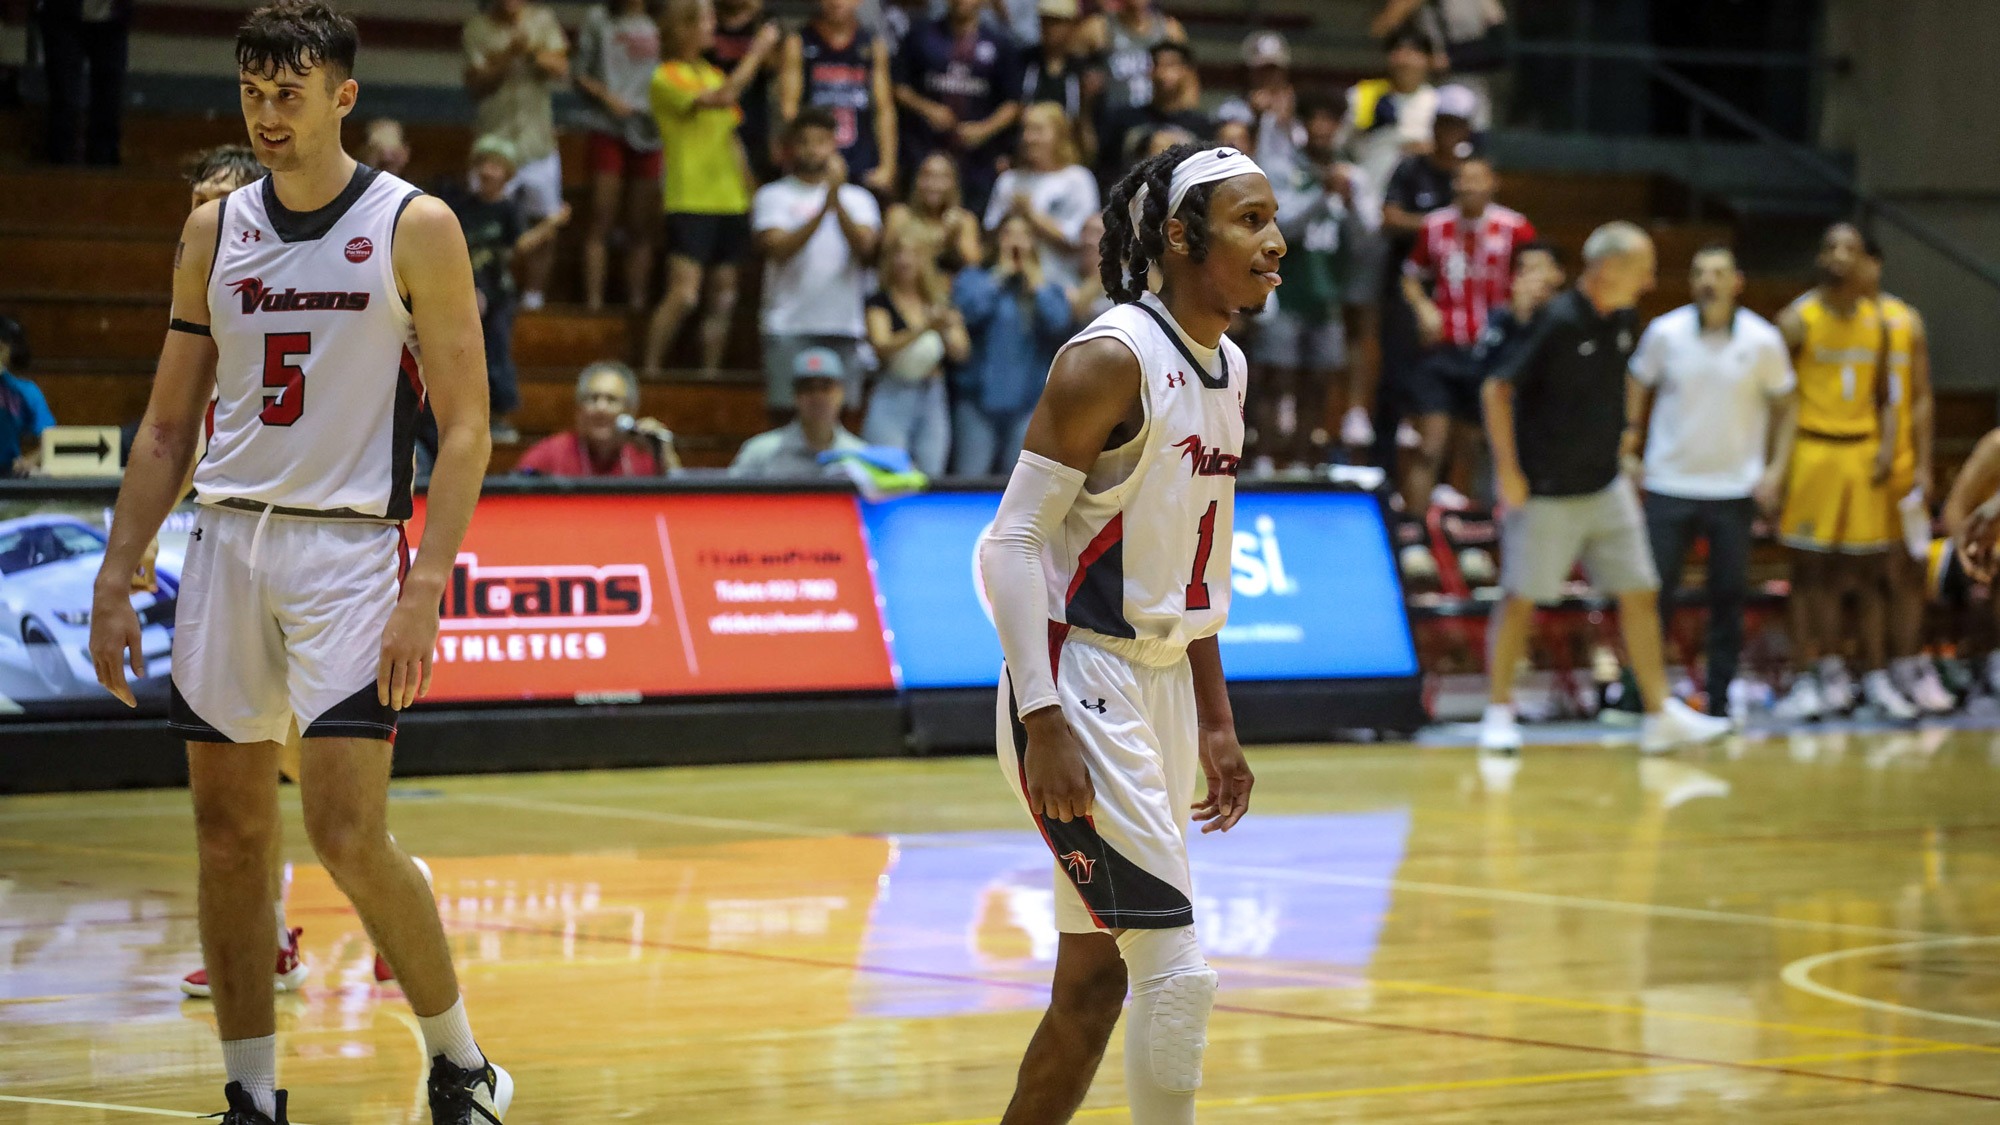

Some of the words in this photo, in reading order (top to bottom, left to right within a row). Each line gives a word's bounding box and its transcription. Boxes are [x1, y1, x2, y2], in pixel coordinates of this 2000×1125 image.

[225, 277, 370, 314] Vulcans
[259, 332, 311, 426] 5
[1171, 434, 1241, 477] Vulca
[1186, 500, 1217, 611] 1
[439, 563, 642, 618] lcans
